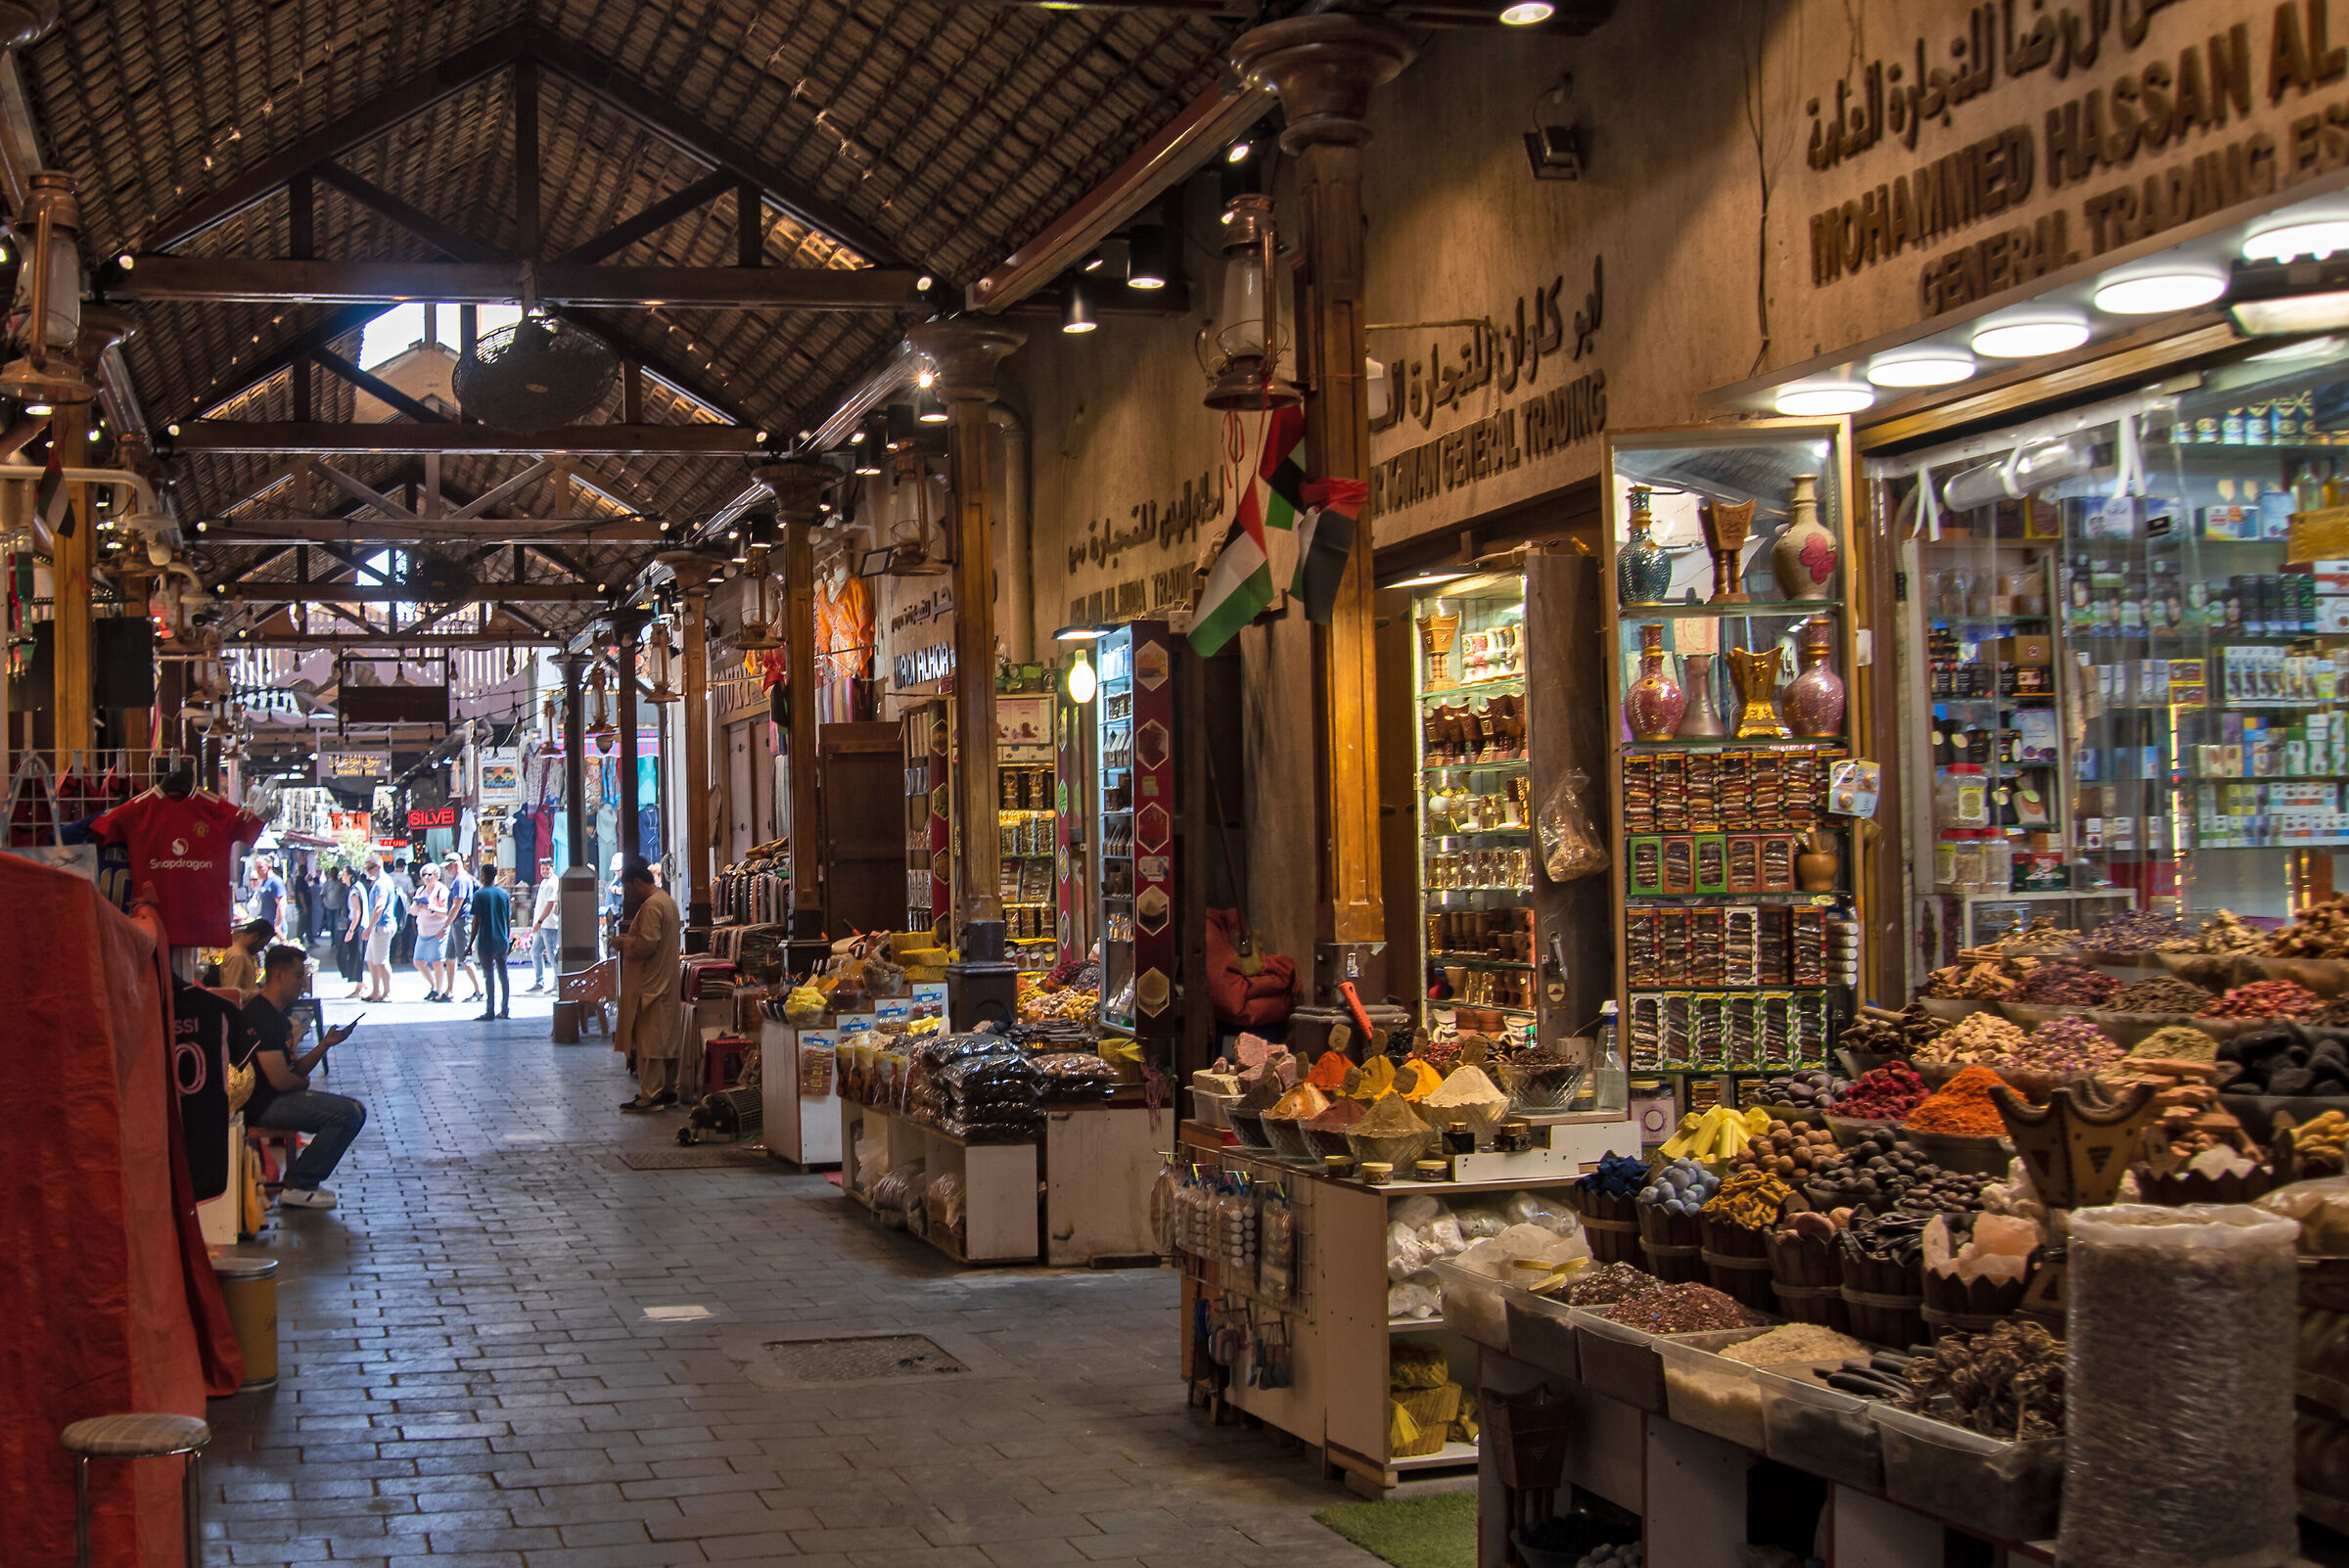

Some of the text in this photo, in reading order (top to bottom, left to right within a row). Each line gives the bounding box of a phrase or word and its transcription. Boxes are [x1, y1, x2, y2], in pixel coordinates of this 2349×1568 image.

[1810, 123, 2035, 287] MOHAMMED
[2044, 22, 2252, 188] HASSAN
[1919, 208, 2081, 319] GENERAL
[2084, 132, 2277, 256] TRADING
[1442, 409, 1521, 494] GENERAL
[1520, 368, 1608, 464] TRADING
[894, 651, 917, 690] WADI
[917, 641, 950, 683] ALHOR
[149, 857, 212, 871] Snapdragon
